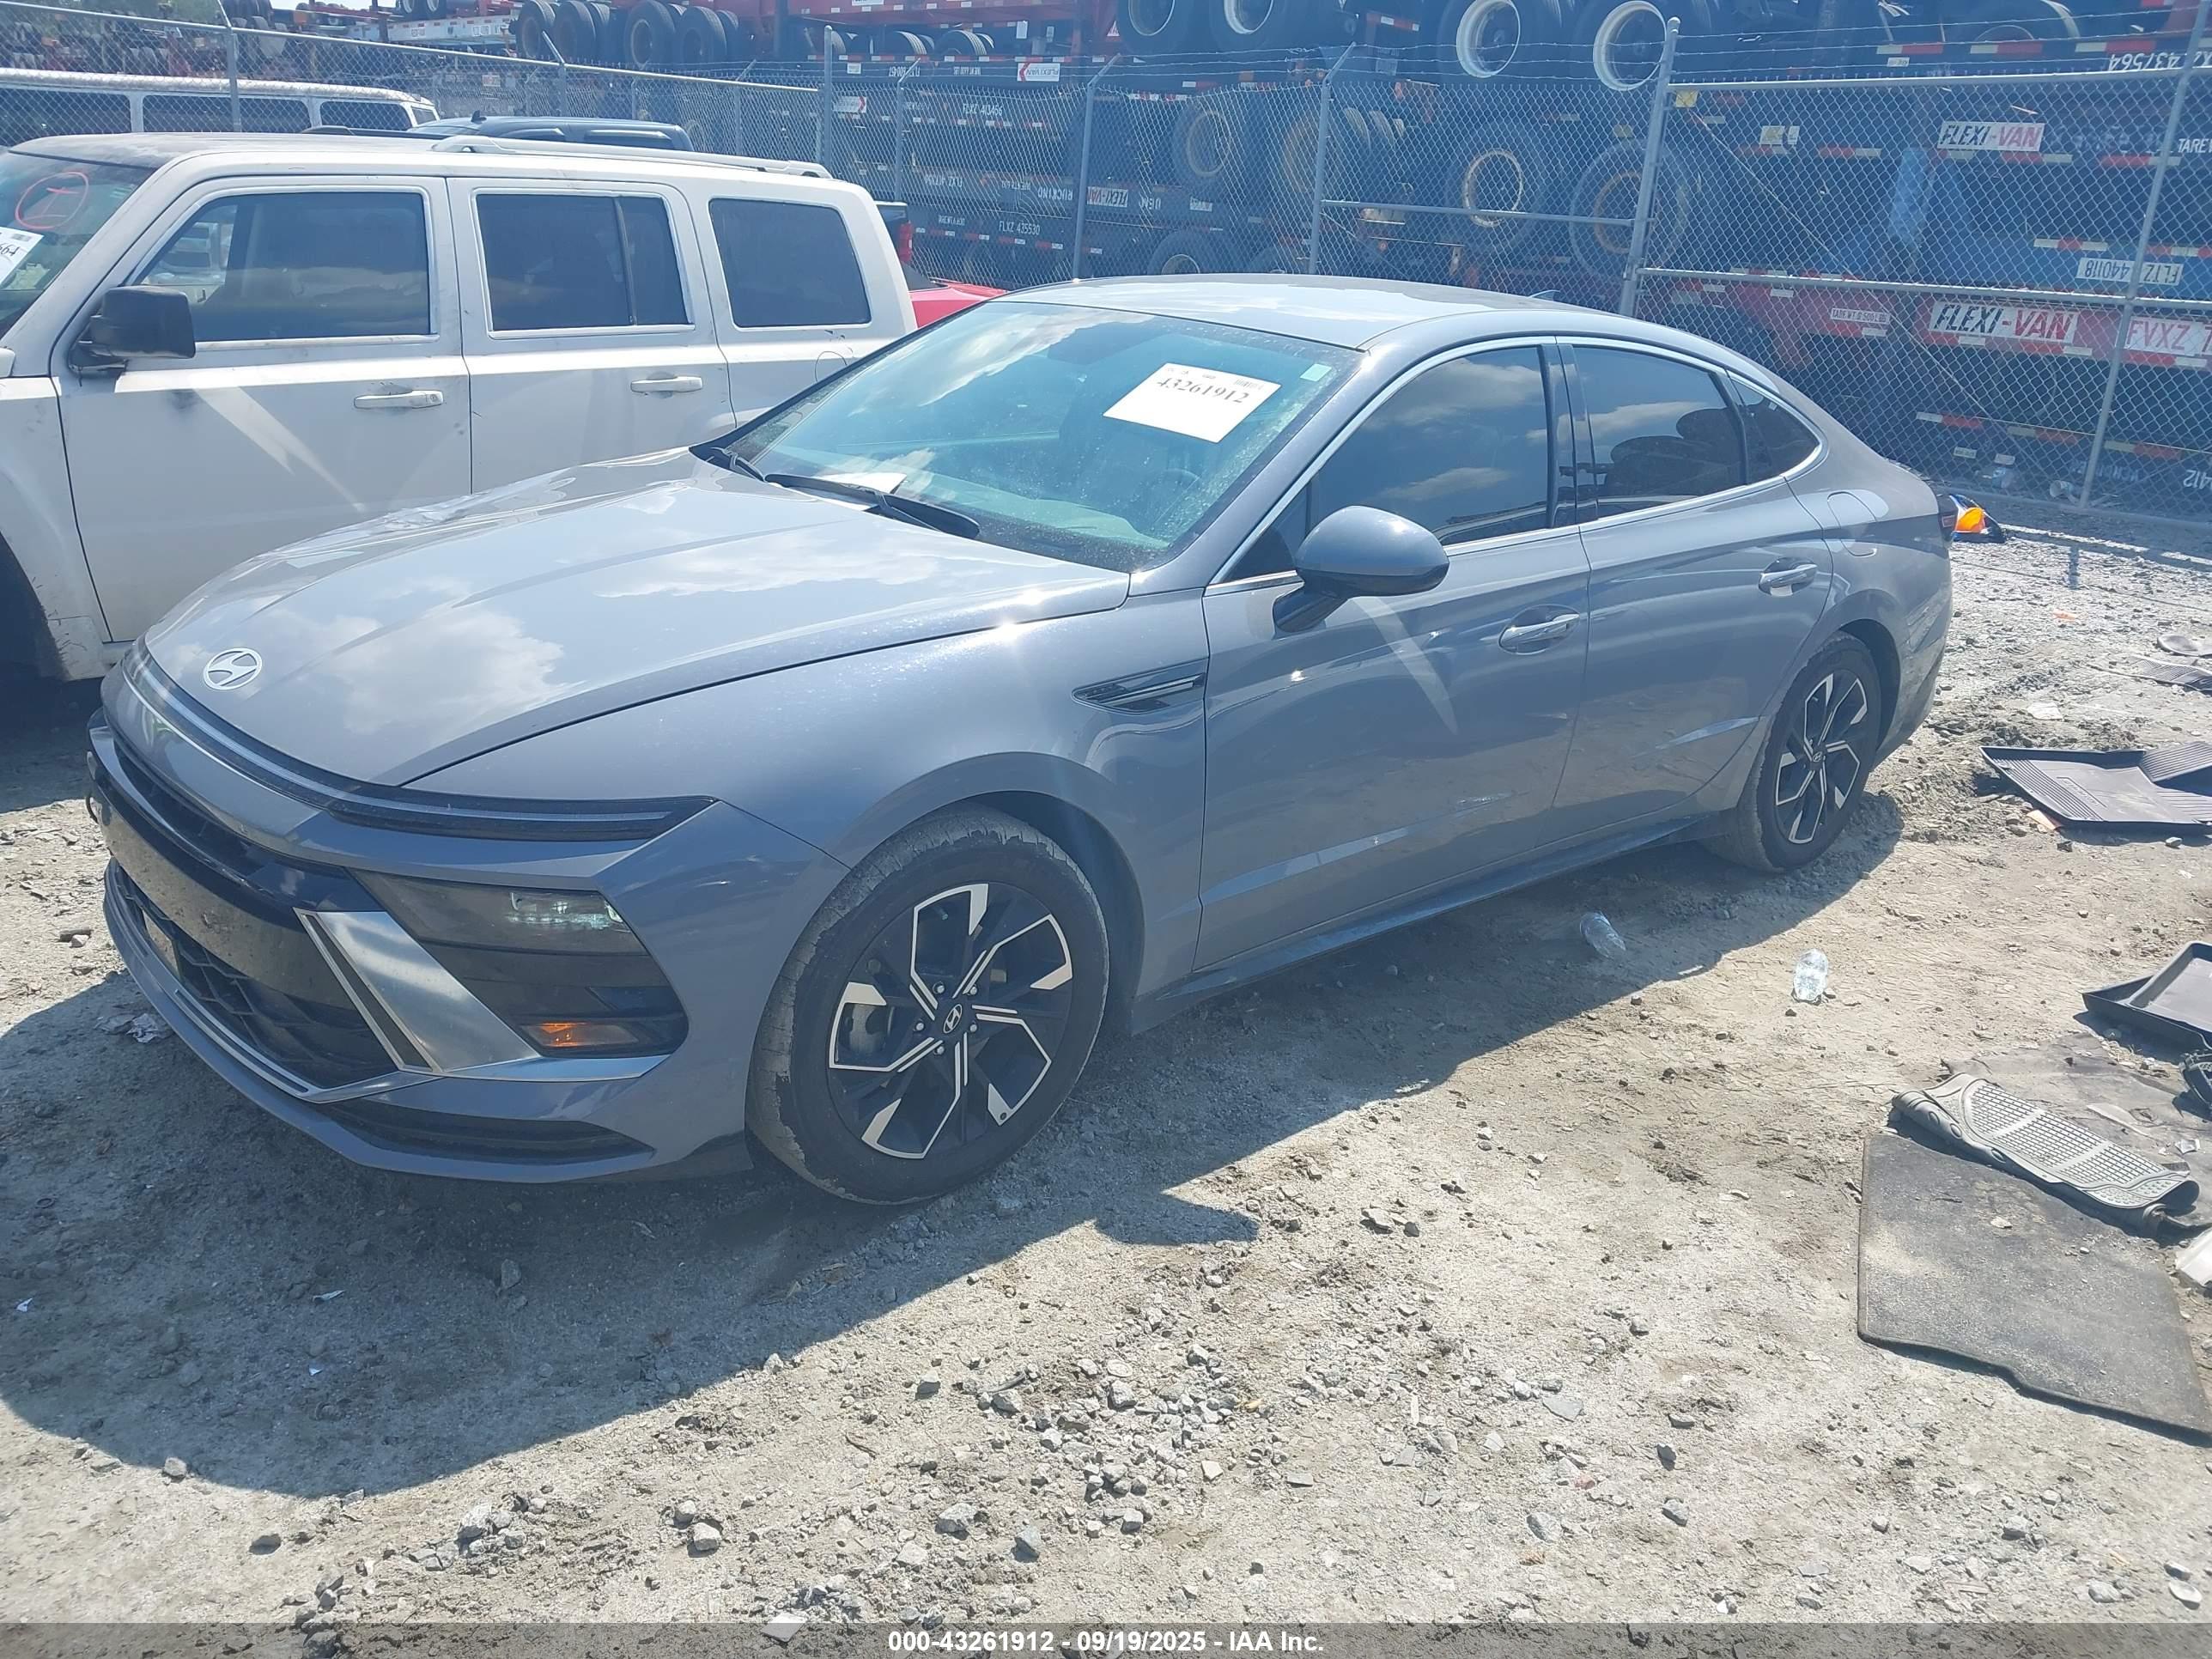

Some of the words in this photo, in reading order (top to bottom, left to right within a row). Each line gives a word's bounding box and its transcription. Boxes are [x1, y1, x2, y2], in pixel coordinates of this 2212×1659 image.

[999, 220, 1014, 233] FLXZ
[1016, 222, 1041, 236] 435530
[2084, 259, 2130, 280] 440118
[1934, 303, 2075, 339] FLEXI-VAN
[2126, 319, 2191, 350] FVXZ
[1157, 377, 1250, 404] 43261912
